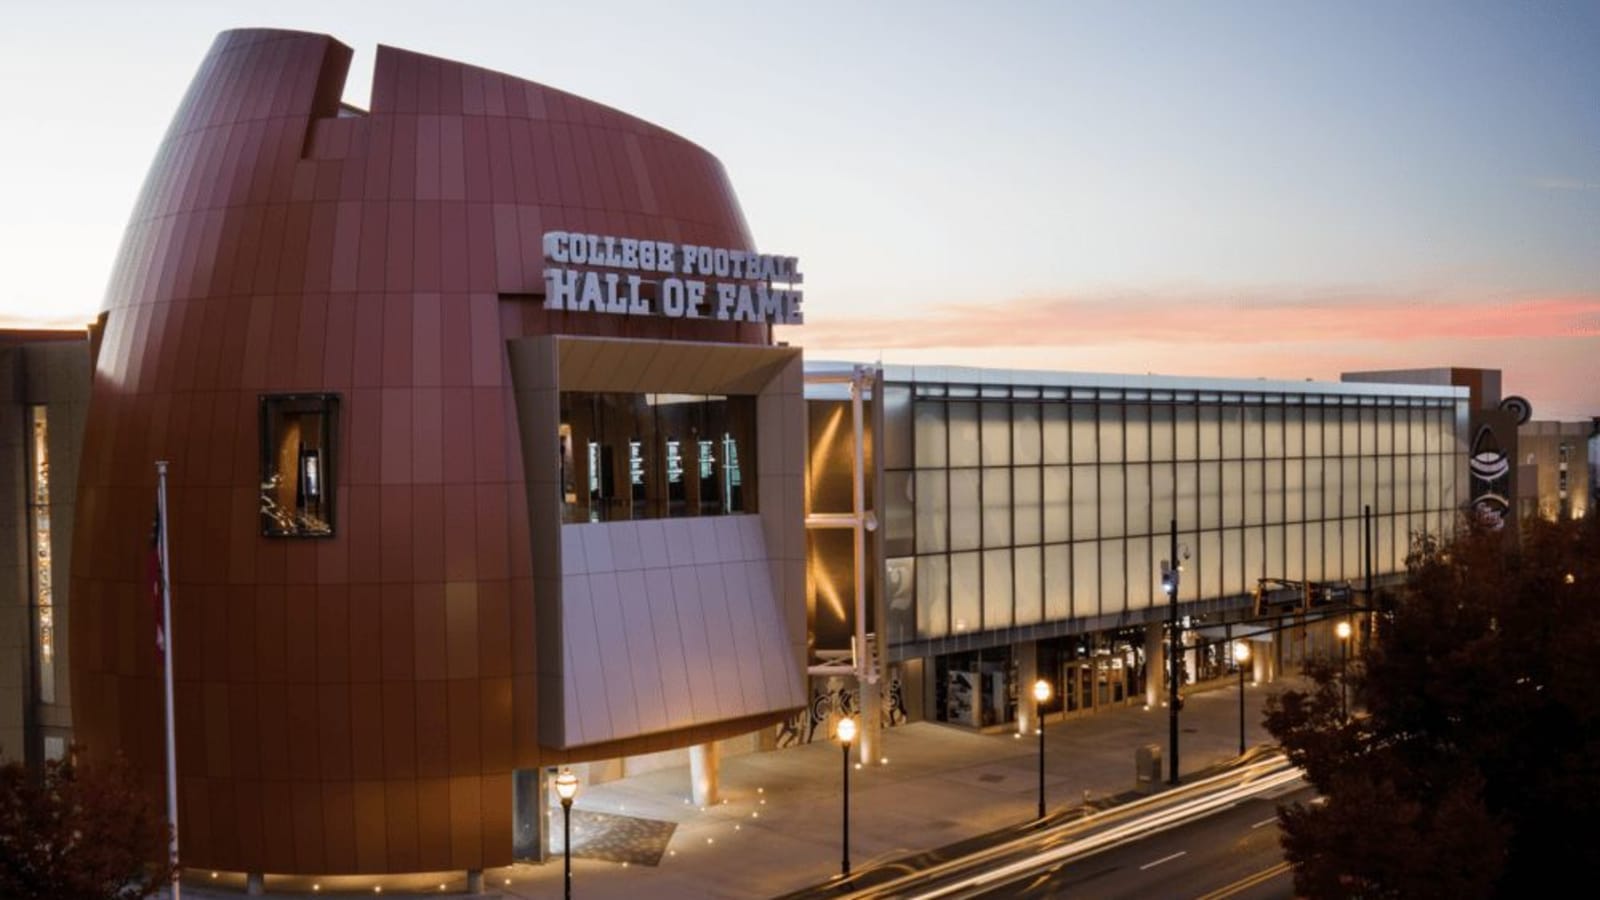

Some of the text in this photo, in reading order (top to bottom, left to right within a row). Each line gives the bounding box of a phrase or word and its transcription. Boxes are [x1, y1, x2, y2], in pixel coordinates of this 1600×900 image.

[544, 231, 803, 283] COLLEGE FOOTBALL
[544, 268, 804, 325] HALL OF FAME
